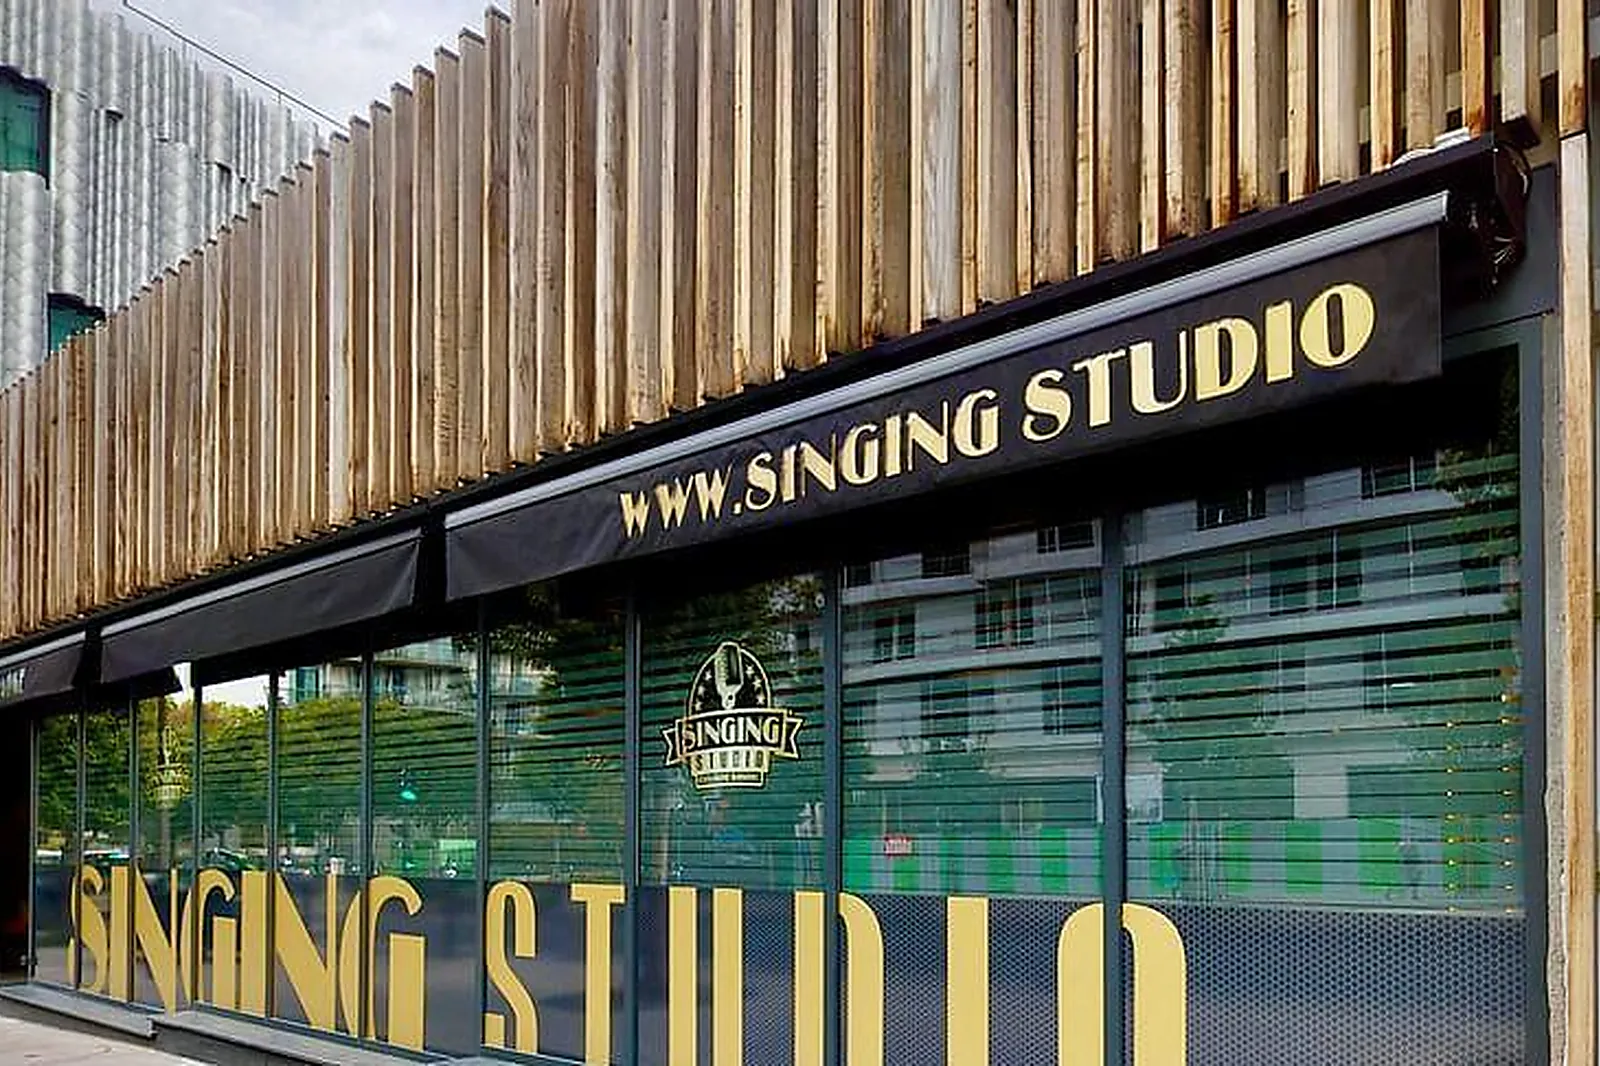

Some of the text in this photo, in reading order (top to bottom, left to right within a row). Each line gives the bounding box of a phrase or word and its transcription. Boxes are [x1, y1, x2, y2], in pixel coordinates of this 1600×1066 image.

[619, 283, 1375, 538] WWW.SINGING STUDIO
[682, 716, 780, 749] SINGING
[65, 864, 426, 1051] SINGING
